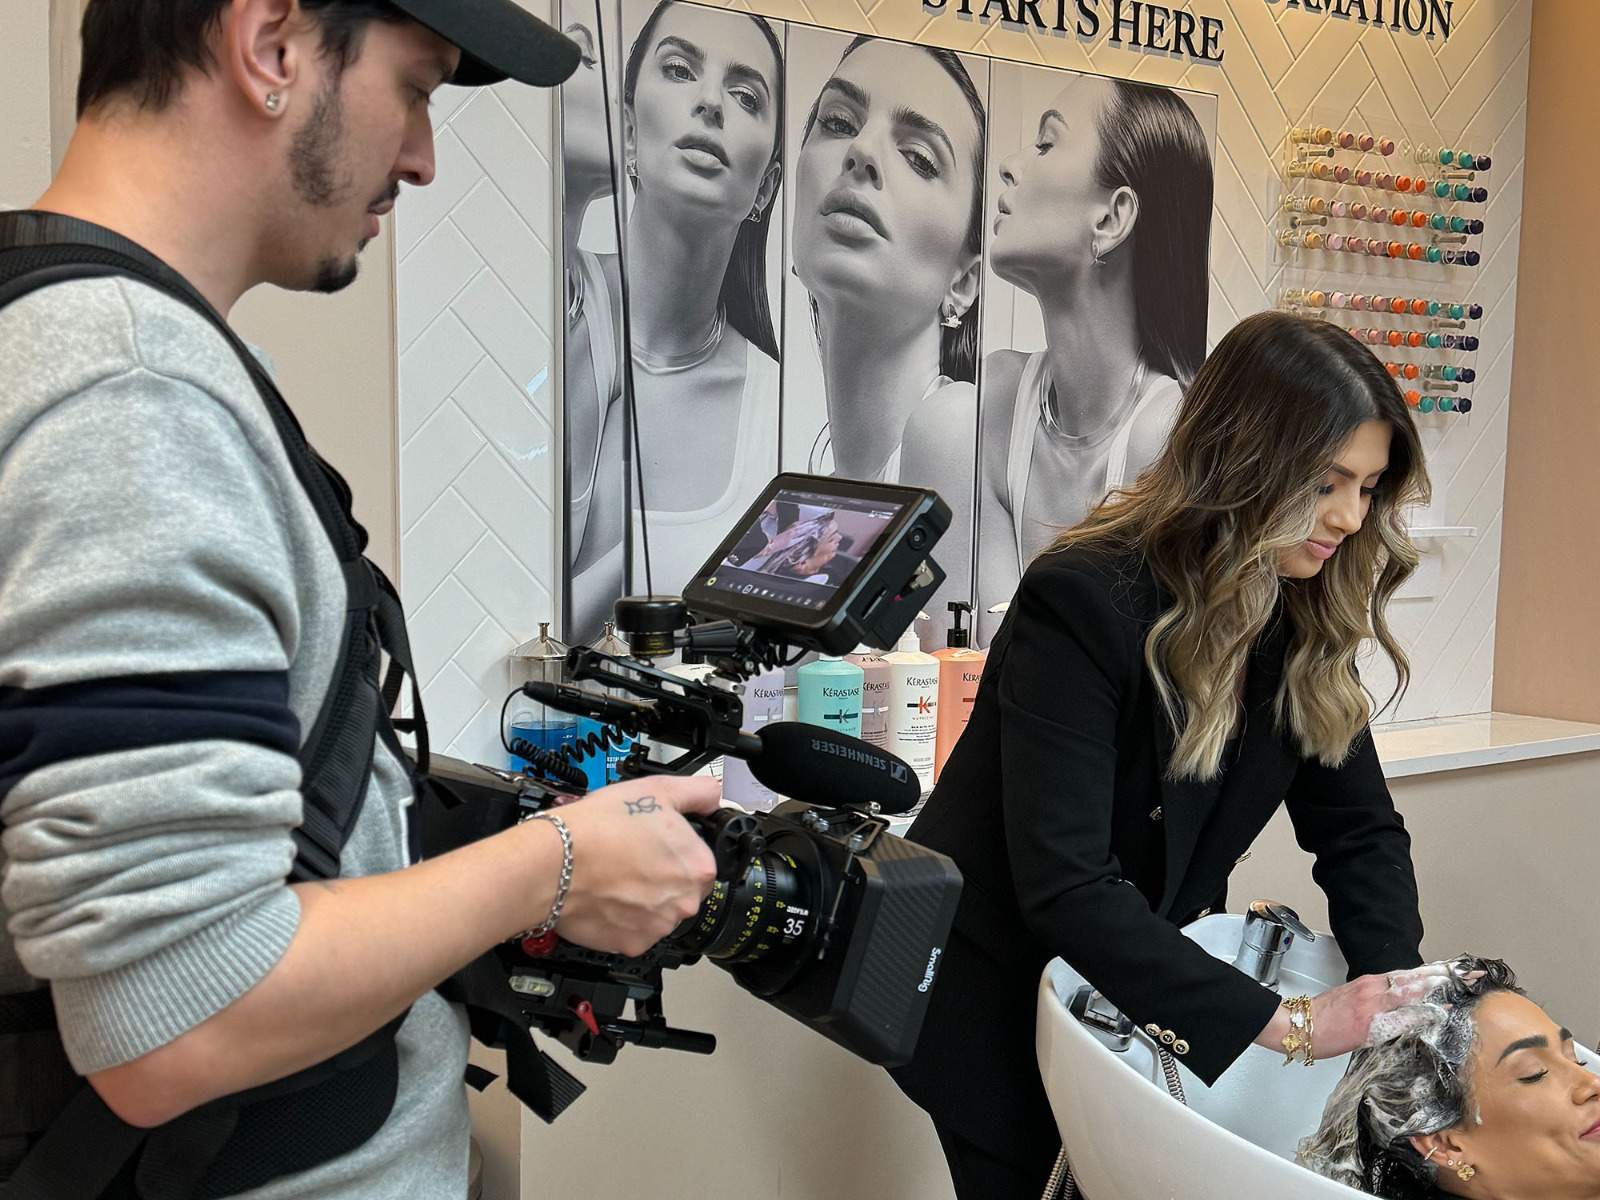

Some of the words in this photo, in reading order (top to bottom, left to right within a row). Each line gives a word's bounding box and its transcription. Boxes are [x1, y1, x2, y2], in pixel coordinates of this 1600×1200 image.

[922, 0, 1099, 37] ARTS
[1109, 0, 1225, 61] HERE
[1287, 0, 1454, 42] ATION
[809, 739, 887, 771] SENNHEISER
[783, 918, 805, 936] 35
